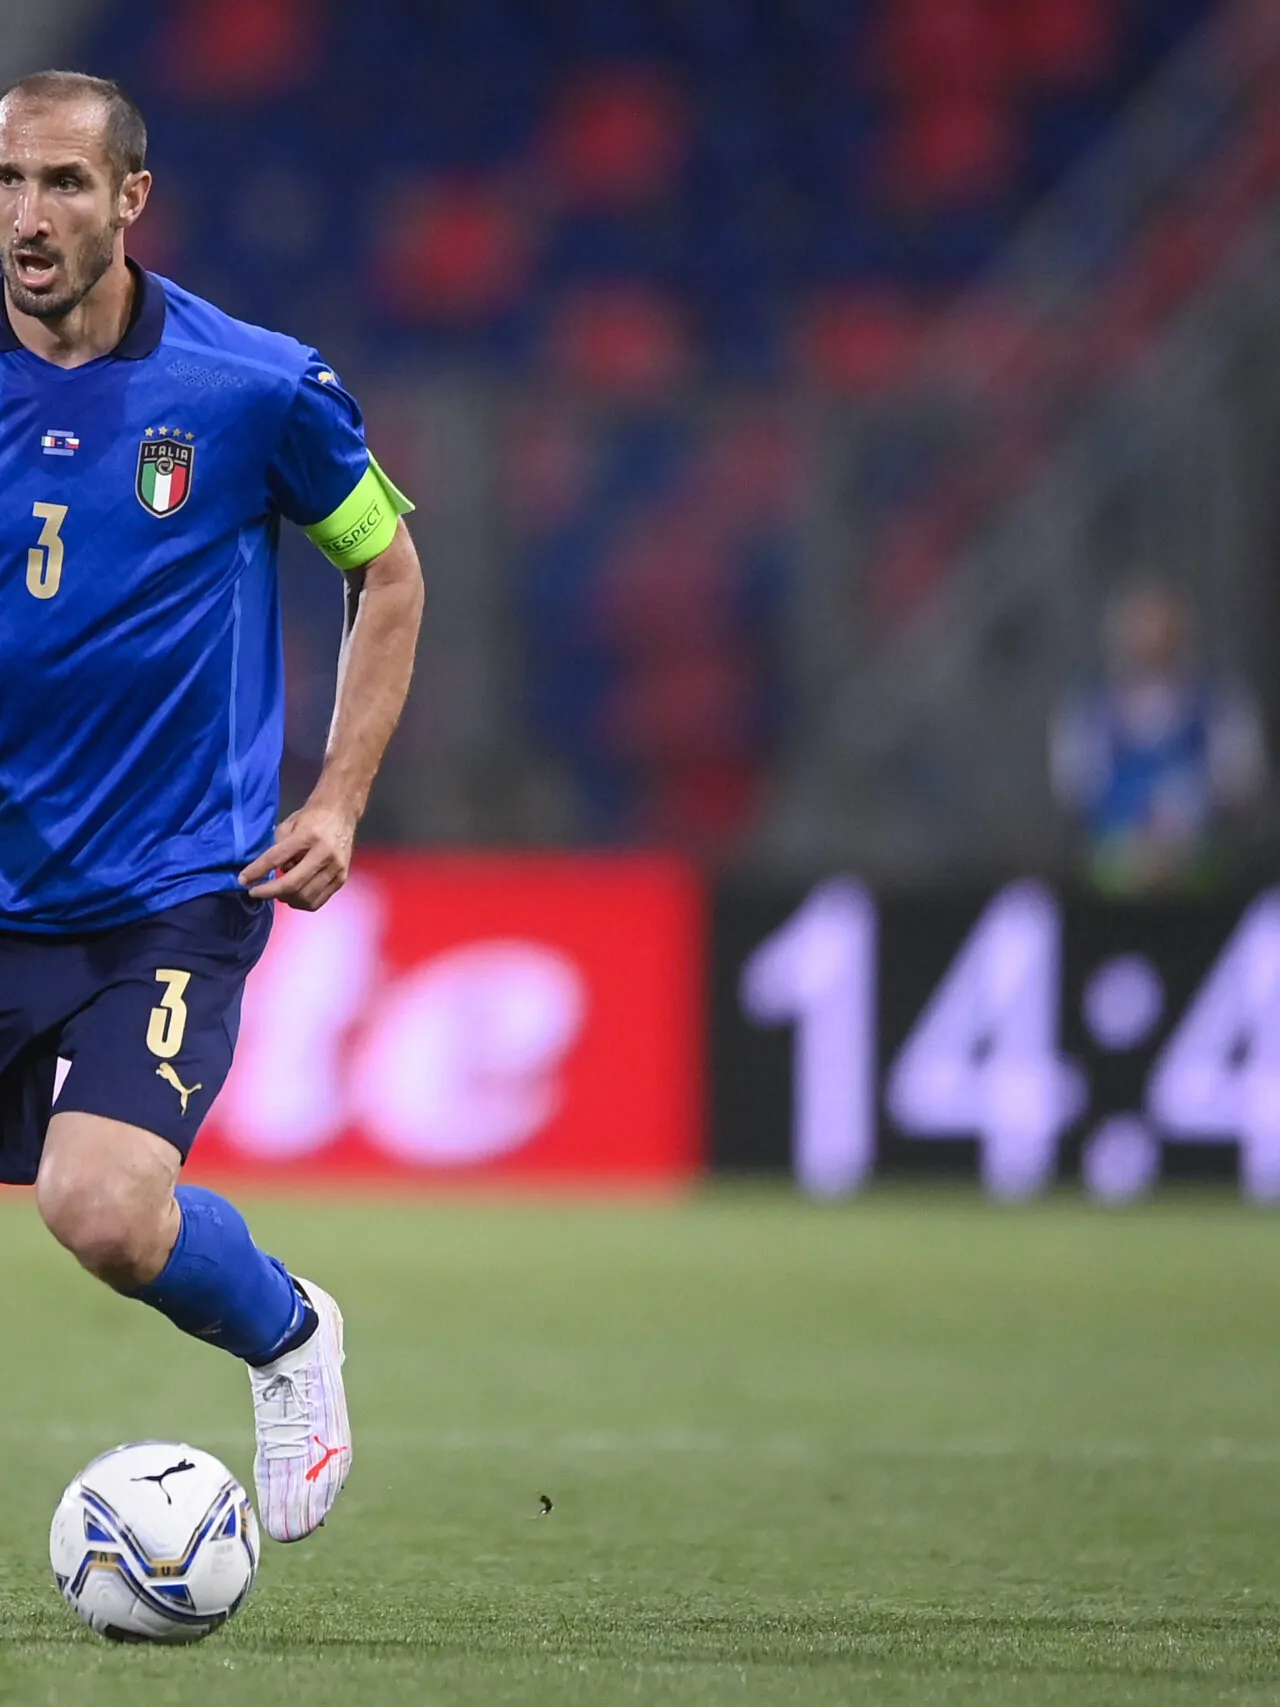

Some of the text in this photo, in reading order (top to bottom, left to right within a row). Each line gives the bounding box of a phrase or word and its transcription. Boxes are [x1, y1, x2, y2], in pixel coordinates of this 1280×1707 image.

[144, 445, 188, 460] ITALIA
[25, 501, 69, 600] 3
[146, 968, 191, 1058] 3
